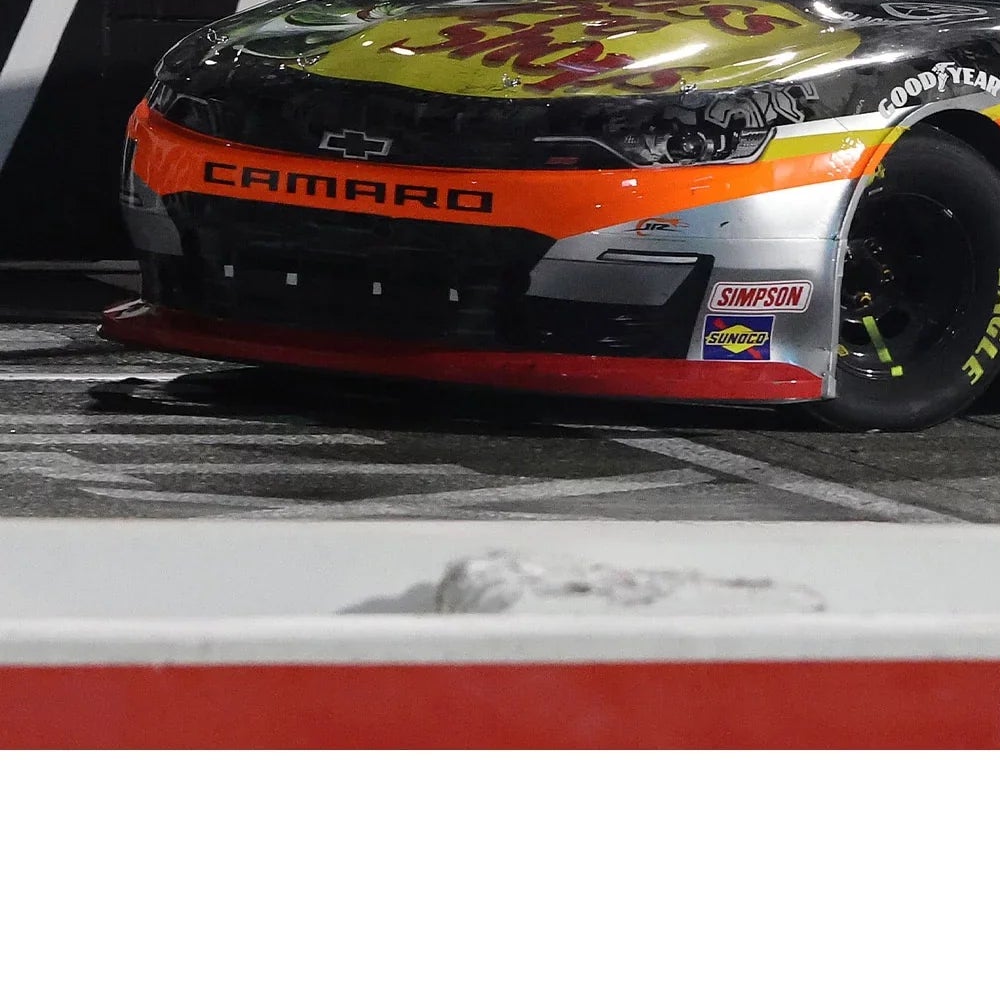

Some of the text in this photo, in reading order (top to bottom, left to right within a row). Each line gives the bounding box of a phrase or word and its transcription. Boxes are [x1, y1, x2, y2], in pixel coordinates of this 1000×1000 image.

[203, 161, 494, 214] CAMARO
[717, 286, 804, 307] SIMPSON
[707, 332, 768, 344] SUNOCO
